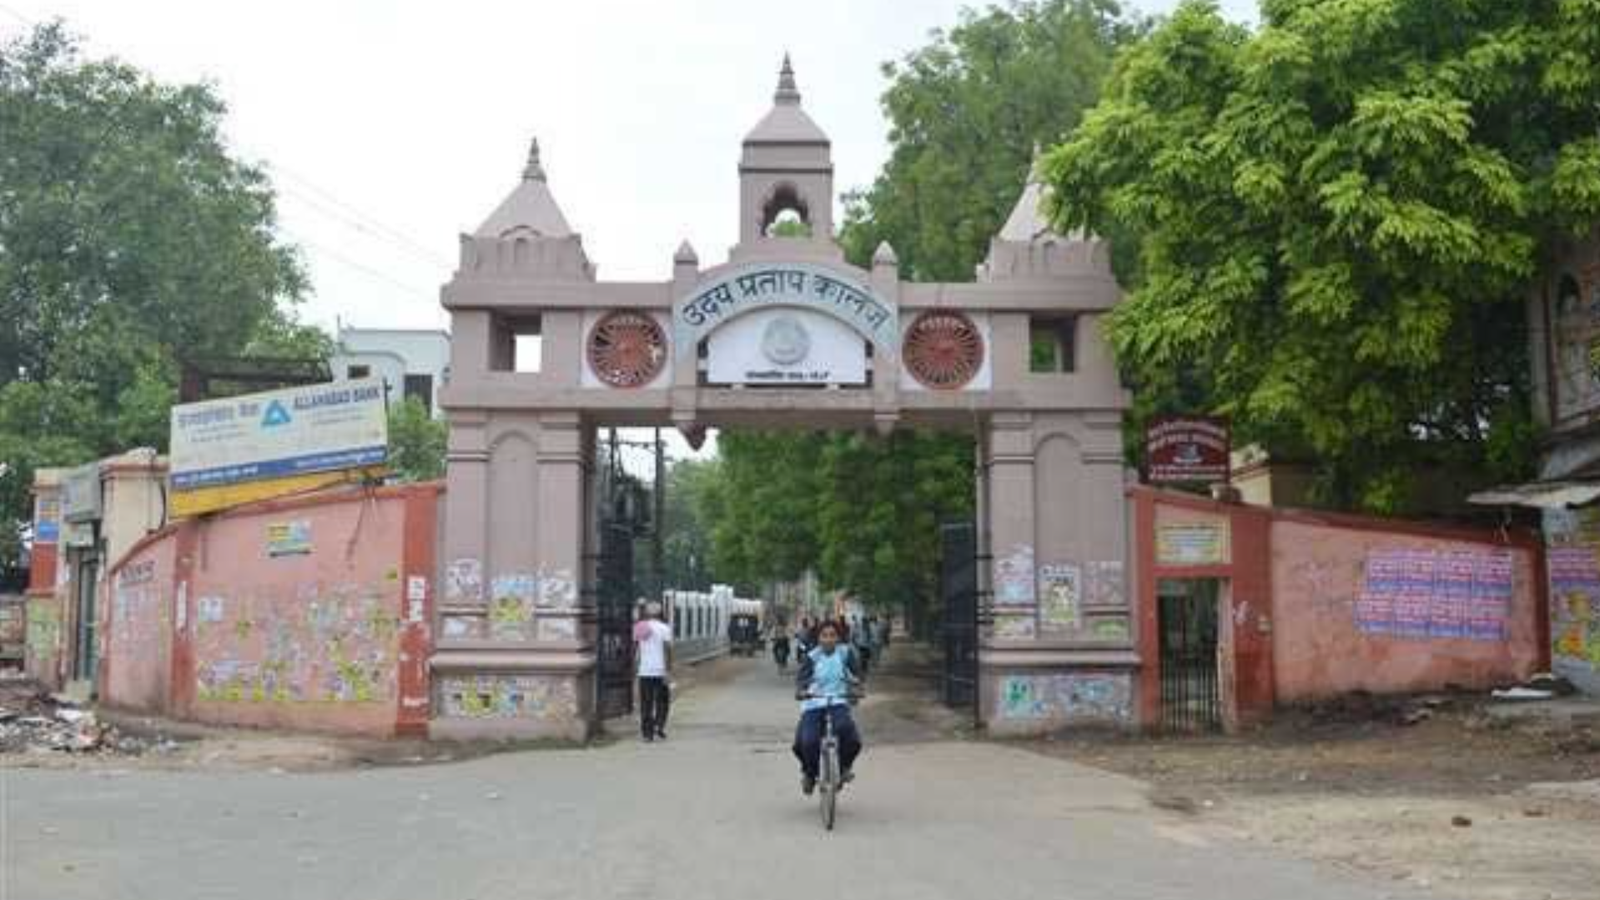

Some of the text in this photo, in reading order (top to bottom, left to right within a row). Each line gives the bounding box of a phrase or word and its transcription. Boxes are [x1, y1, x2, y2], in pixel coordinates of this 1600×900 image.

[683, 282, 734, 326] उदय
[736, 270, 806, 297] प्रताप
[294, 387, 381, 409] ALLAHABAD BANK
